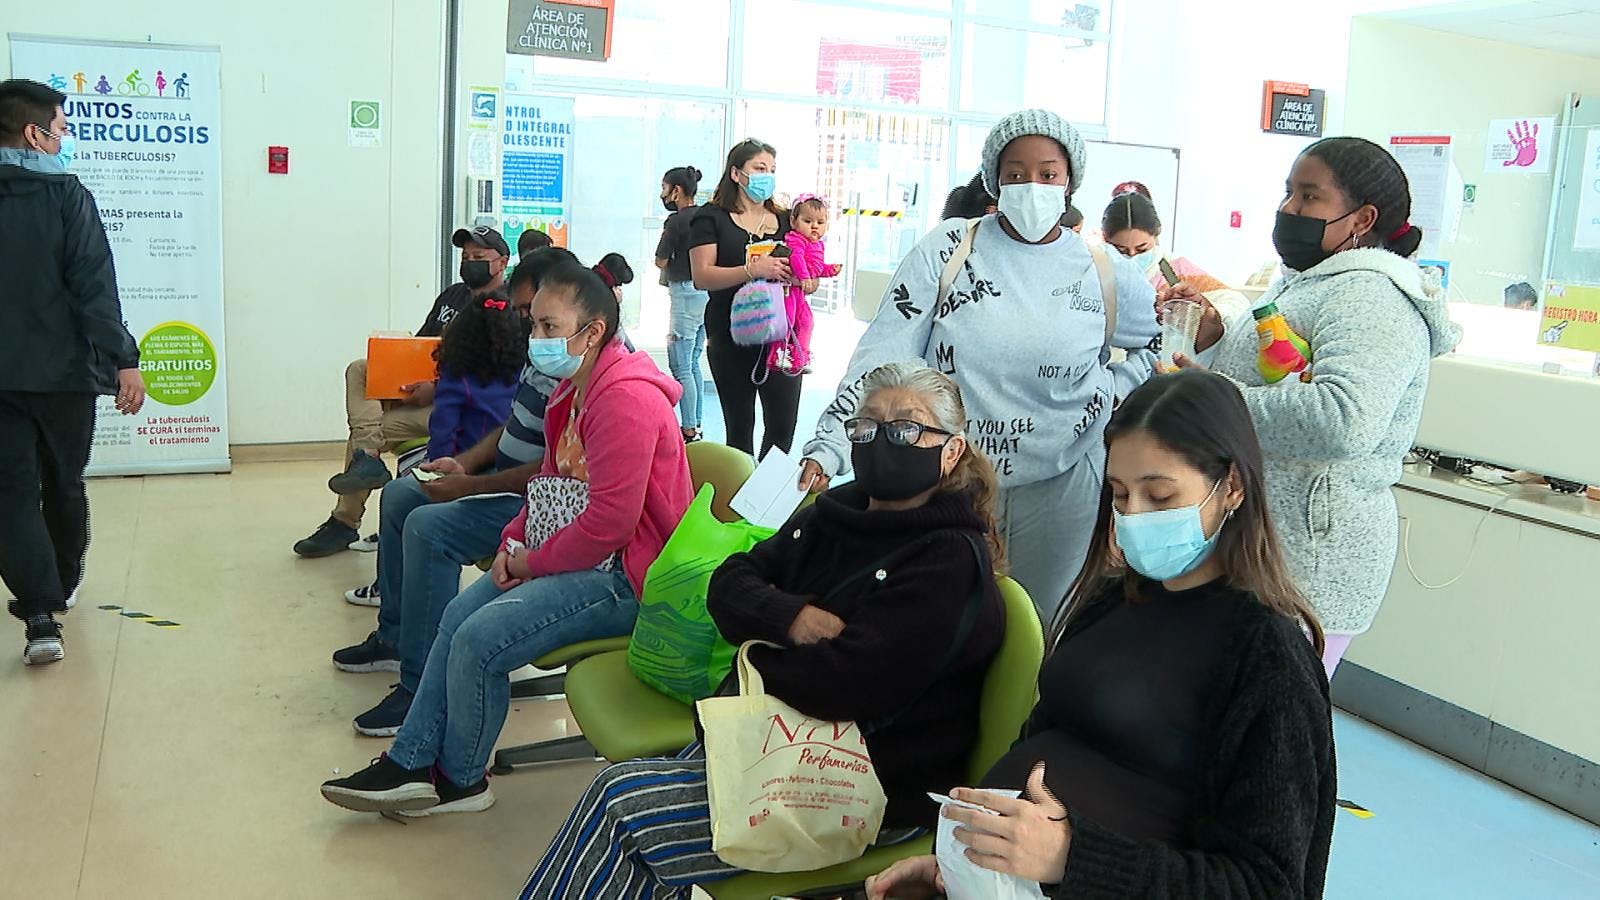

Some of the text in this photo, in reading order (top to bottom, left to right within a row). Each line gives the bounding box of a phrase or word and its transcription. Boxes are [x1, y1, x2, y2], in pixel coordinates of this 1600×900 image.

[532, 5, 585, 25] ÁREA DE
[526, 22, 588, 39] ATENCIÓN
[519, 34, 568, 51] CLÍNICA
[62, 101, 191, 121] UNTOS CONTRA LA
[505, 105, 541, 118] NTROL
[1283, 98, 1314, 113] ÁREA DE
[1279, 110, 1316, 122] ATENCIÓN
[65, 122, 209, 144] BERCULOSIS
[517, 120, 571, 135] INTEGRAL
[1275, 120, 1303, 132] CLÍNICA
[503, 133, 565, 148] OLESCENTE
[81, 151, 90, 160] la
[93, 151, 176, 162] TUBERCULOSIS?
[126, 209, 171, 220] presenta
[173, 209, 183, 219] la
[1543, 306, 1598, 324] REGISTRO HORA
[139, 360, 212, 371] GRATUITOS
[1038, 364, 1062, 379] NOT
[1063, 366, 1071, 379] A
[147, 415, 210, 425] La tuberculosis
[977, 418, 1005, 435] YOU
[1010, 416, 1035, 435] SEE
[137, 424, 221, 435] SE CURA si terminas
[149, 435, 210, 445] el tratamiento
